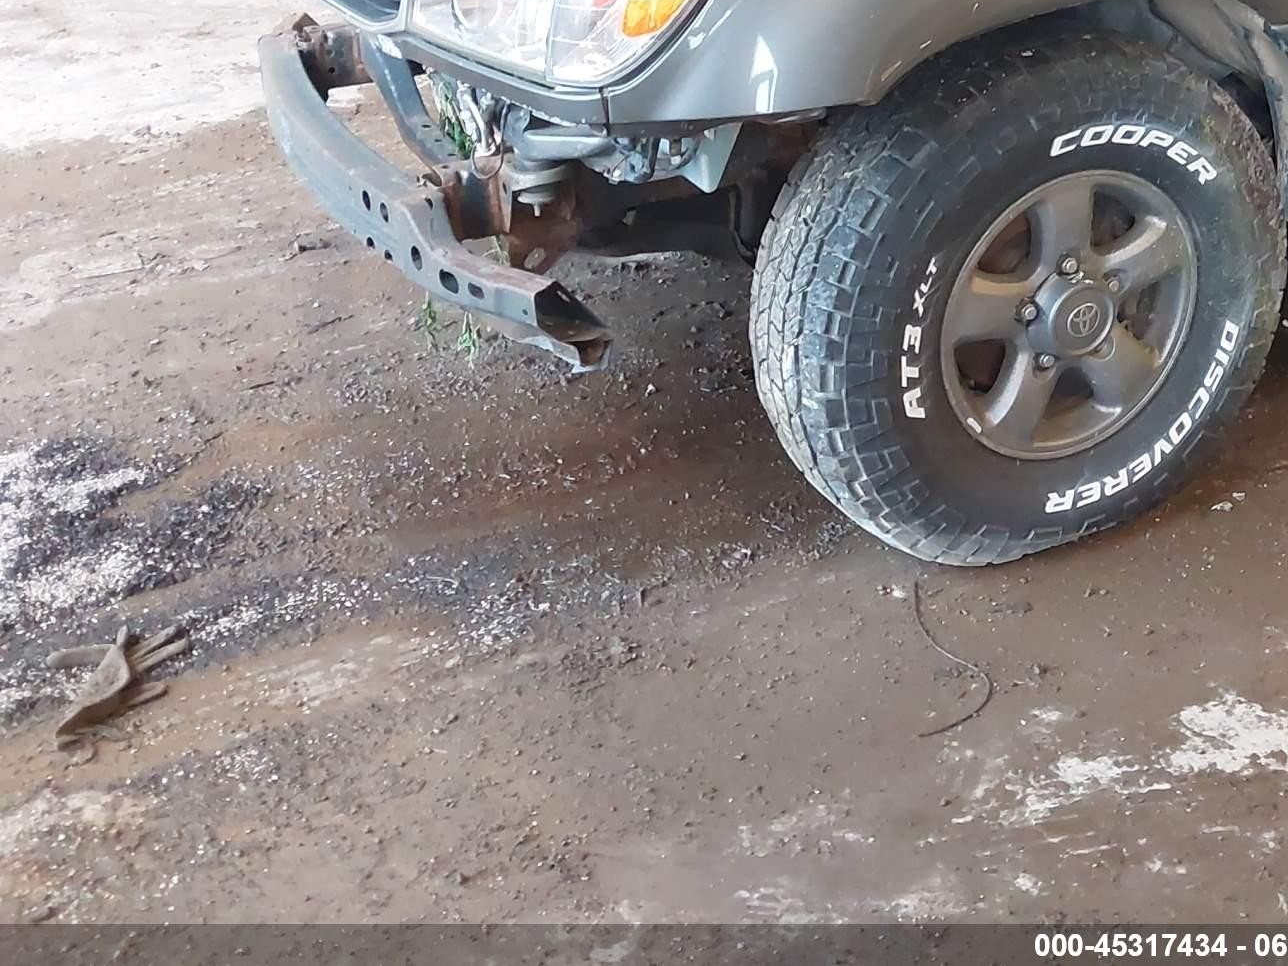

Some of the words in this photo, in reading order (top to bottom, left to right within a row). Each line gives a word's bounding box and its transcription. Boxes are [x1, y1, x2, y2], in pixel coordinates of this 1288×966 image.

[1049, 123, 1218, 185] COOPER
[912, 256, 938, 318] XLT
[900, 323, 926, 419] AT3
[1044, 319, 1239, 514] DISCOVERER
